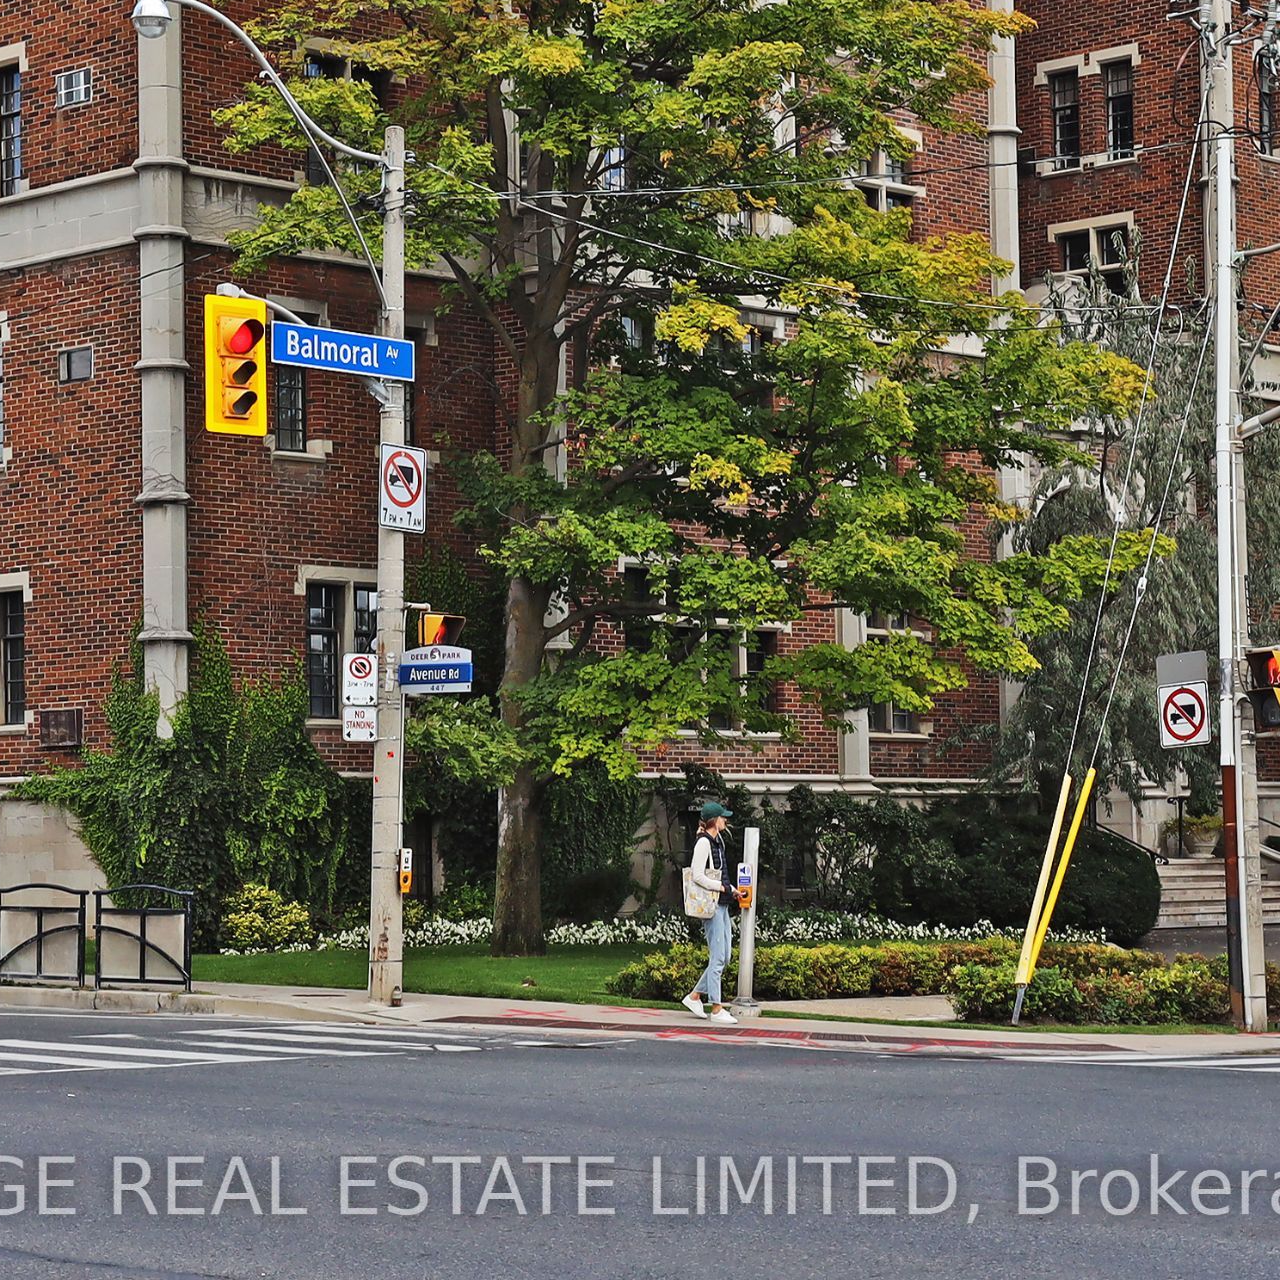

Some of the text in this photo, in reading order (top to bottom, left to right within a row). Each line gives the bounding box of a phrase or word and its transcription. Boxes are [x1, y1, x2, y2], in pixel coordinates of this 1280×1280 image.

[287, 330, 399, 368] Balmoral Av
[410, 652, 461, 661] DEER PARK
[410, 667, 460, 681] Avenue Rd
[354, 710, 366, 719] NO
[345, 720, 375, 730] STANDING
